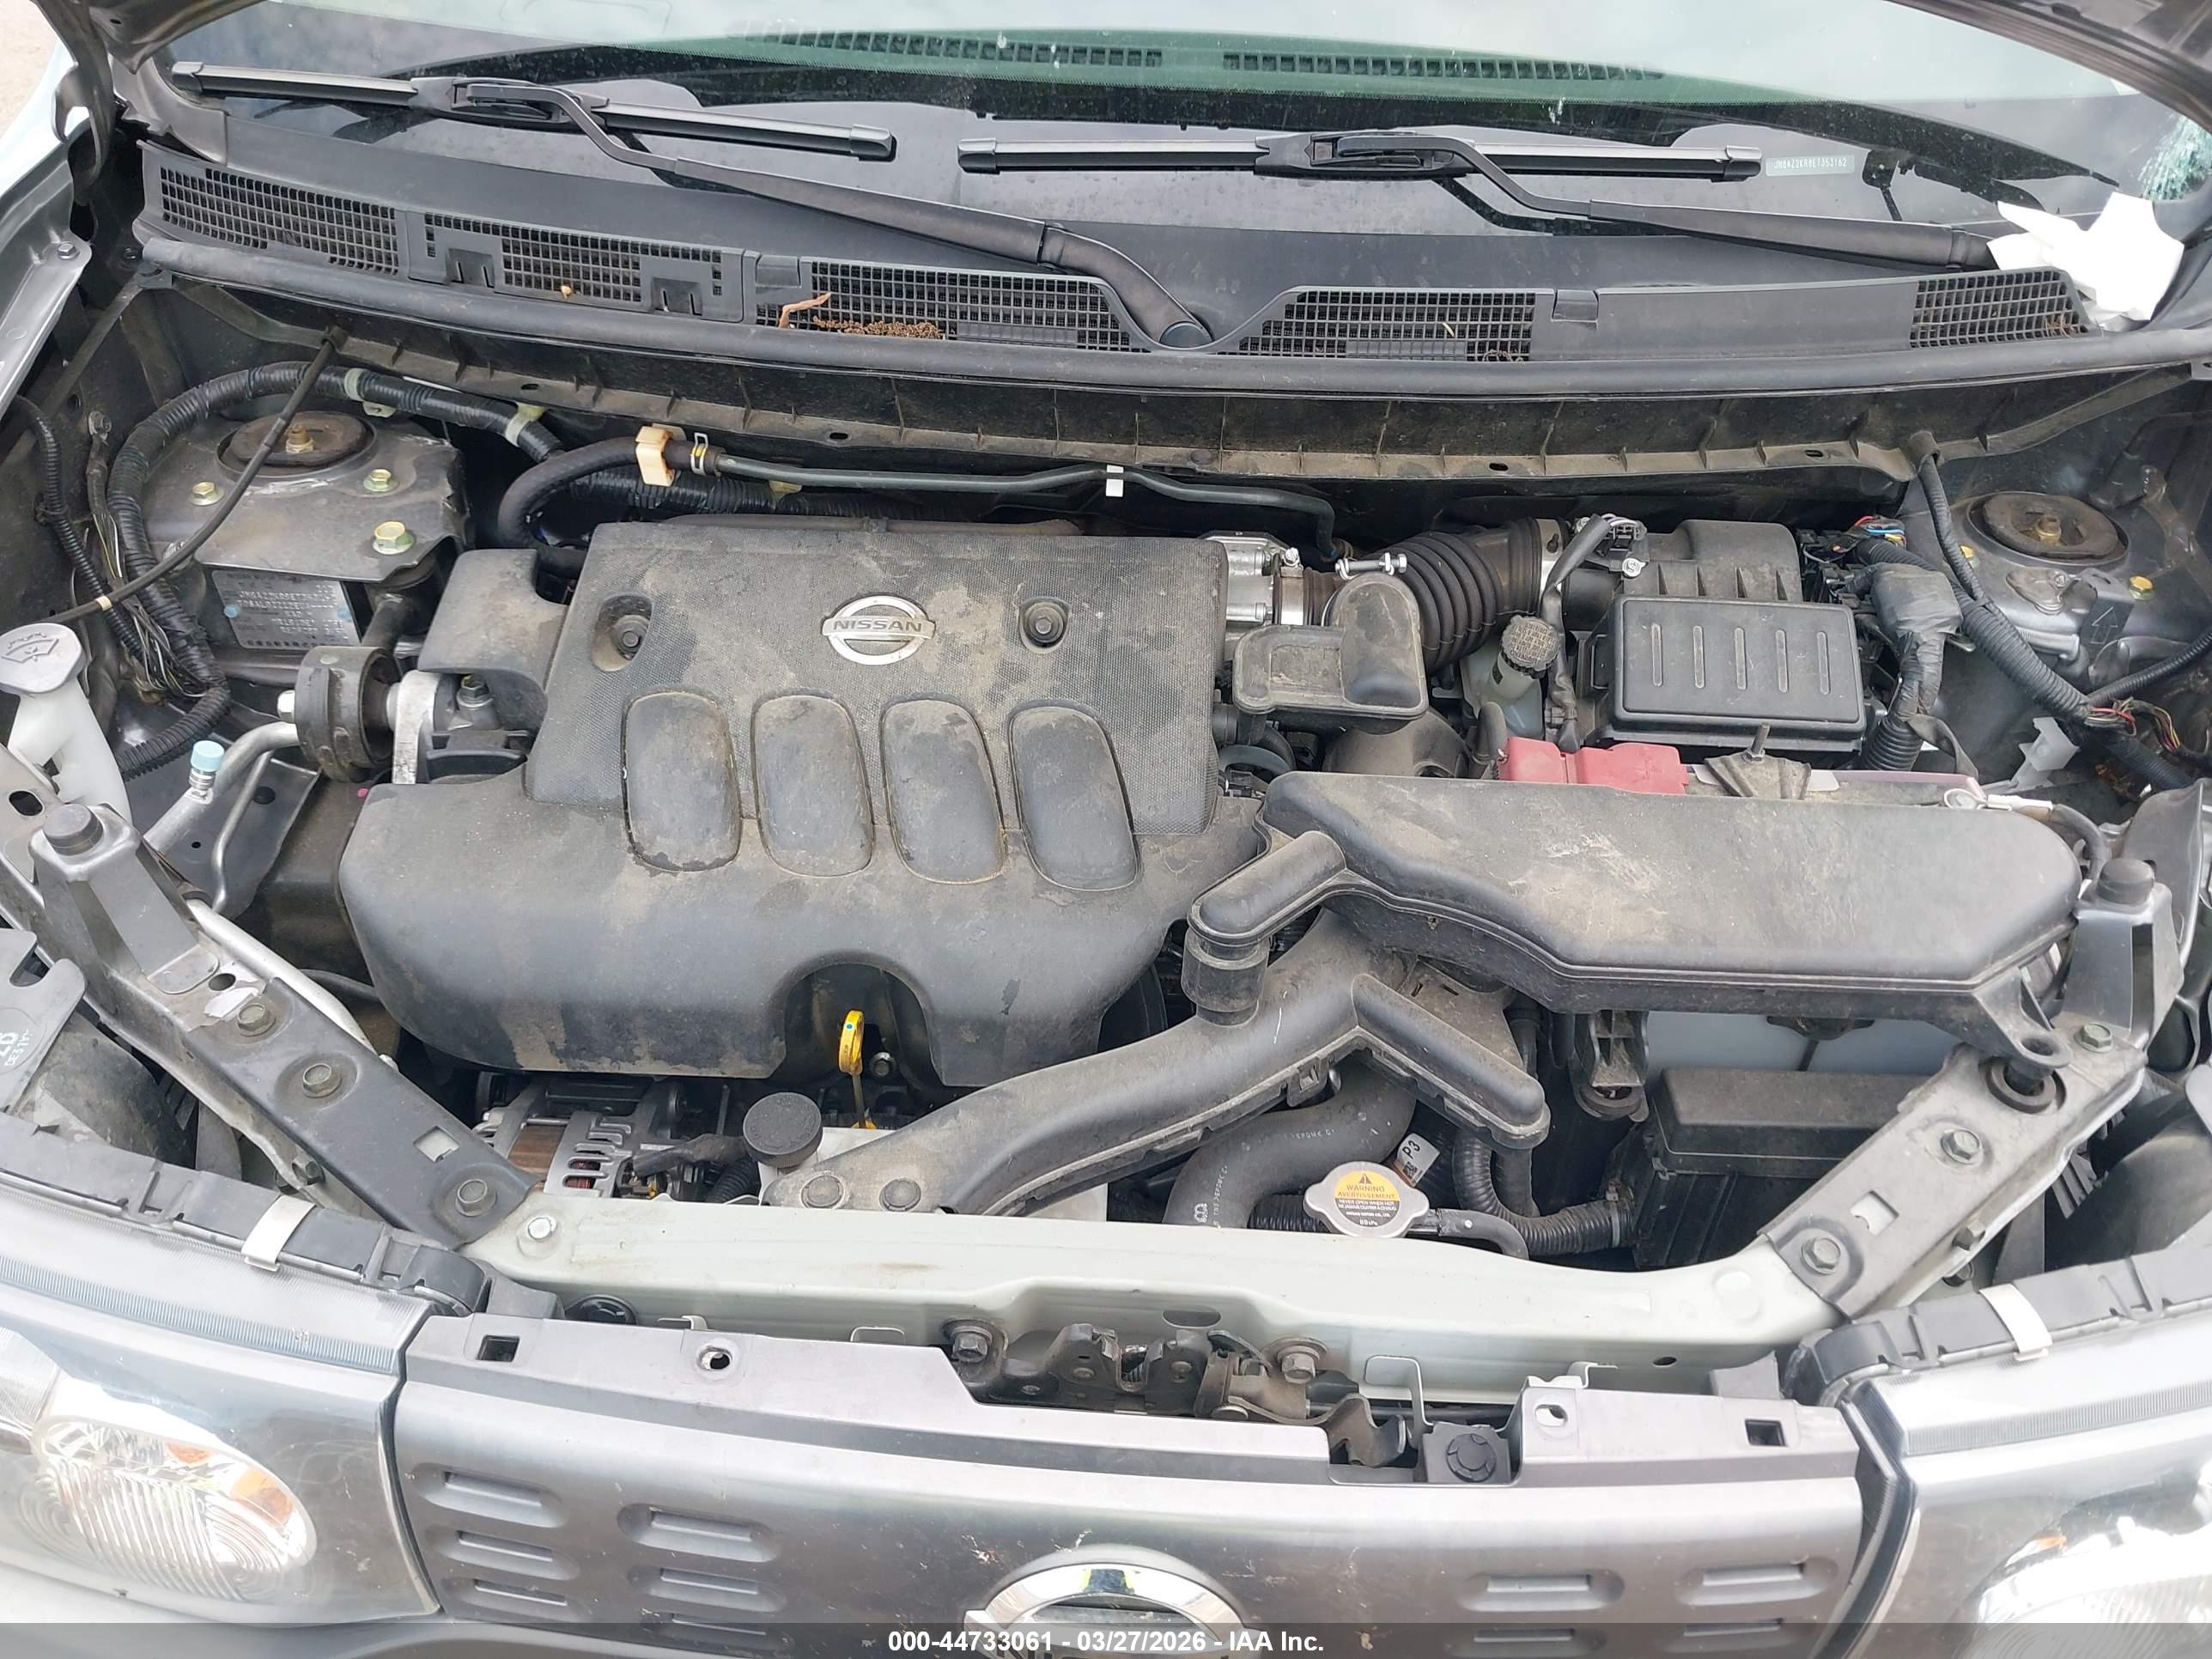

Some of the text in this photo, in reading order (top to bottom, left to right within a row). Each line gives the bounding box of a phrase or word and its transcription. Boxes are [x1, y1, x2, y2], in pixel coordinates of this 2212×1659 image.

[833, 620, 922, 632] NISSAN
[1401, 1139, 1421, 1159] P3
[1346, 1183, 1385, 1193] WARNING
